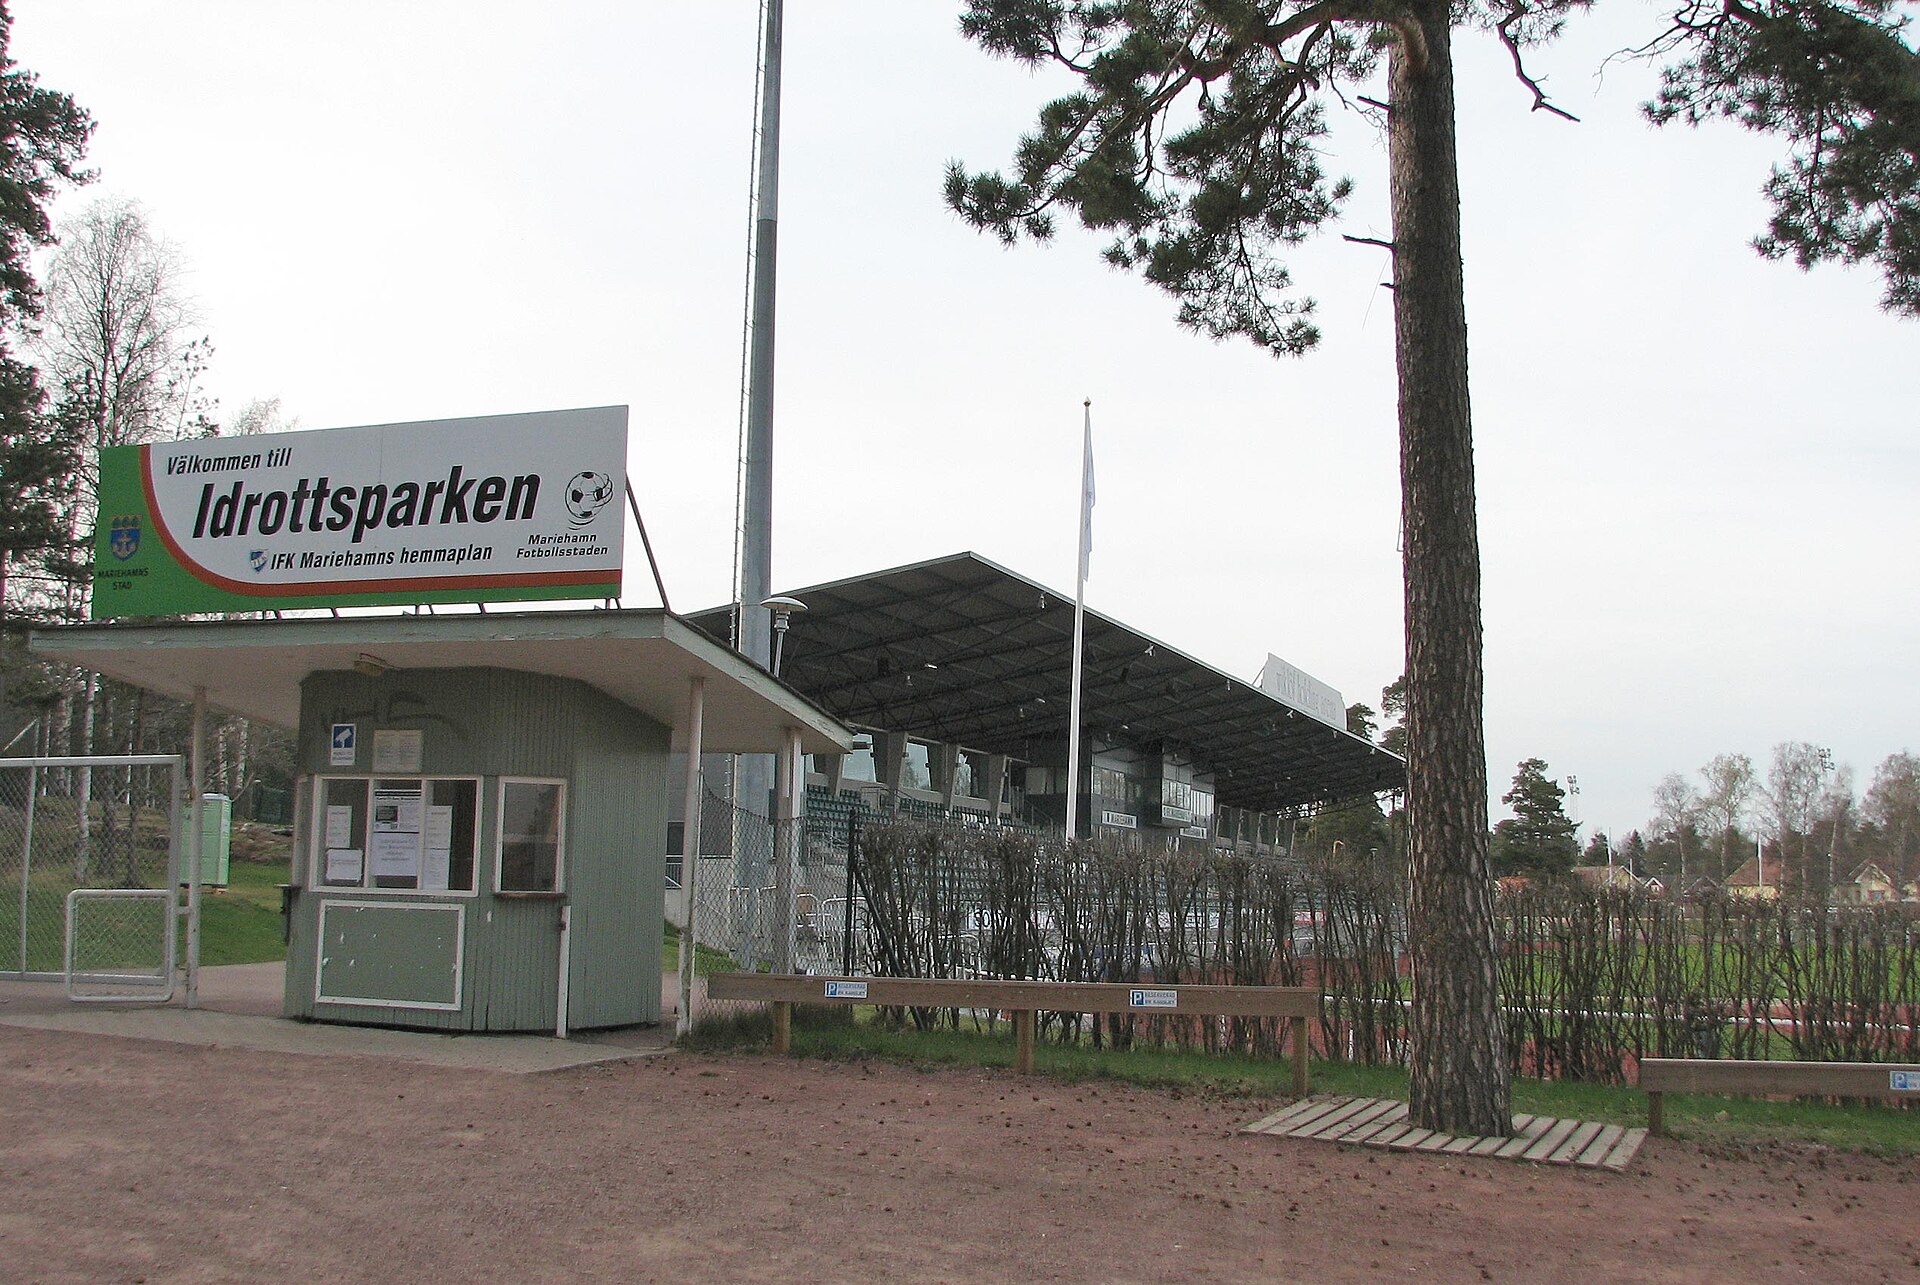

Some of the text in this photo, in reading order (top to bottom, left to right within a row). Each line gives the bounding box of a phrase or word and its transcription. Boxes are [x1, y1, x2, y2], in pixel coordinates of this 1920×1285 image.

[167, 448, 293, 475] Välkommen till
[192, 465, 541, 543] Idrottsparken
[528, 533, 597, 545] Mariehamn
[270, 552, 296, 570] IFK
[300, 550, 395, 569] Mariehamns
[400, 543, 493, 565] hemmaplan
[516, 545, 608, 558] Fotbollsstaden
[98, 567, 149, 578] MARIEHAMNS
[113, 581, 133, 591] STAD
